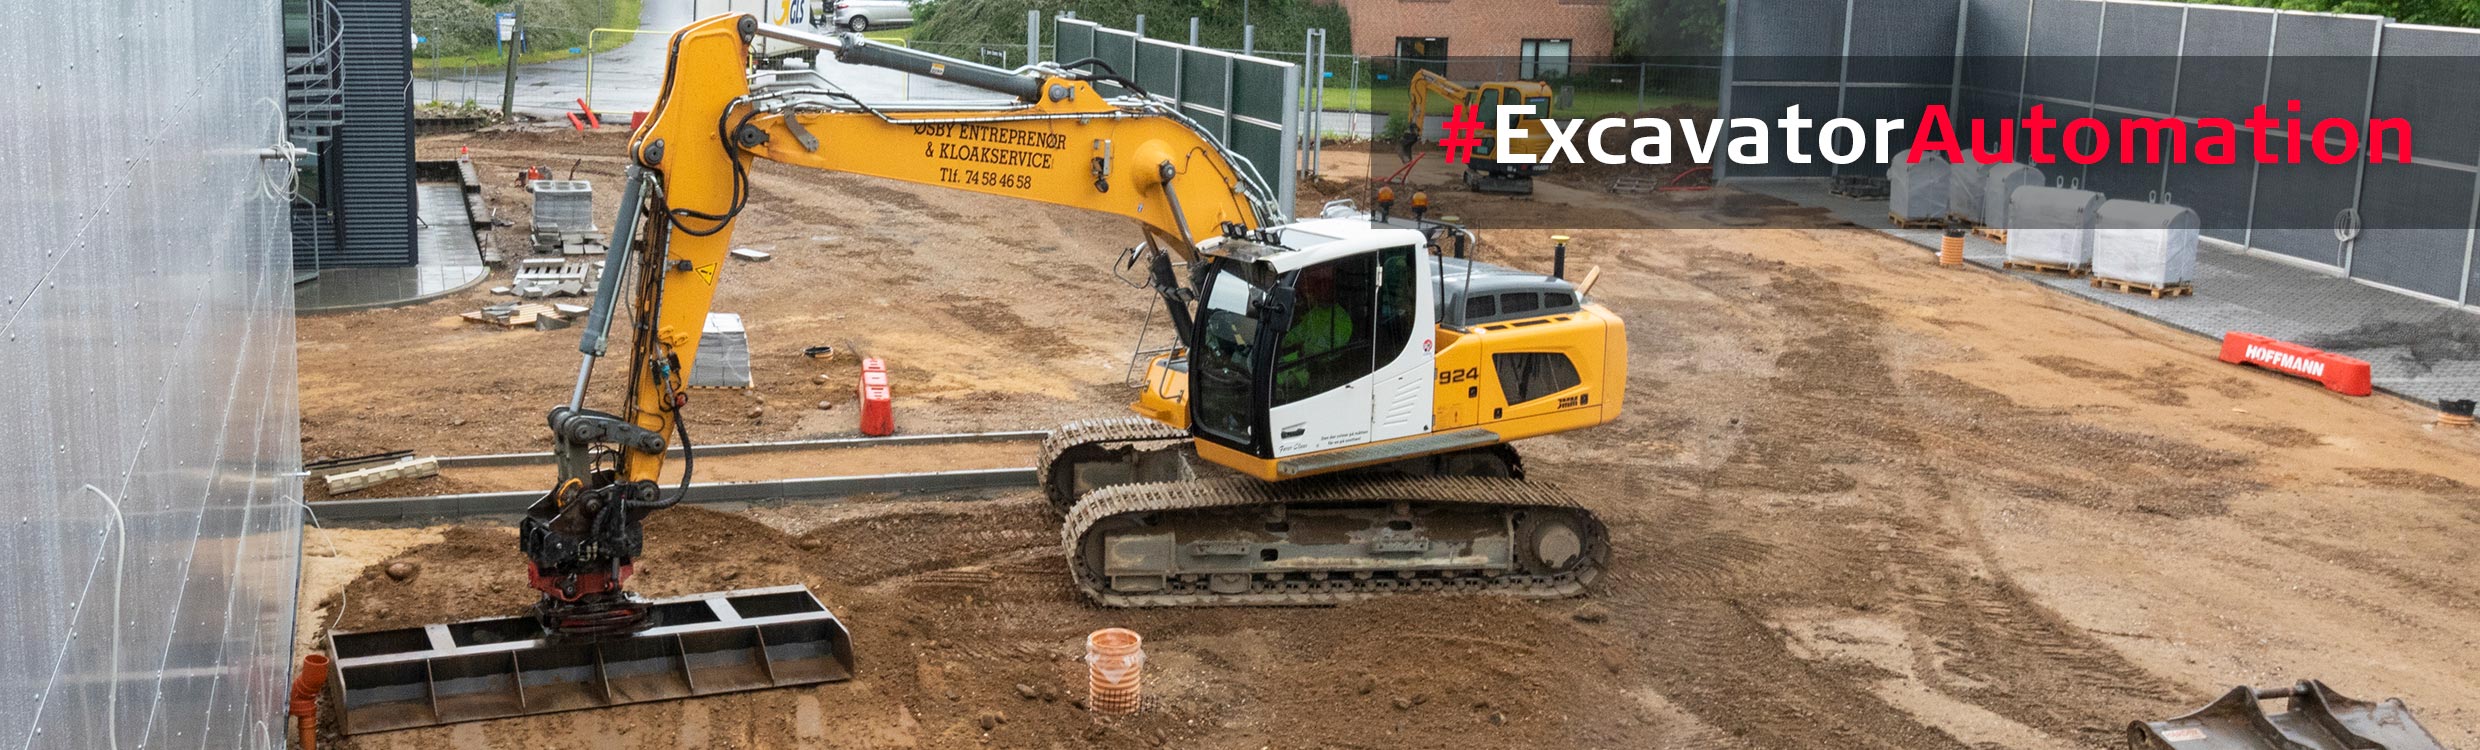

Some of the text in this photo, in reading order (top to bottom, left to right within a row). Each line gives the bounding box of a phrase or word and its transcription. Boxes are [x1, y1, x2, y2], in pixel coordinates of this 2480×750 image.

[913, 123, 1066, 150] ØSBY ENTREPRENØR
[925, 141, 1052, 169] & KLOAKSERVICE
[940, 167, 961, 183] Tlf.
[2245, 343, 2325, 377] HOFFMANN
[1439, 366, 1479, 385] 924
